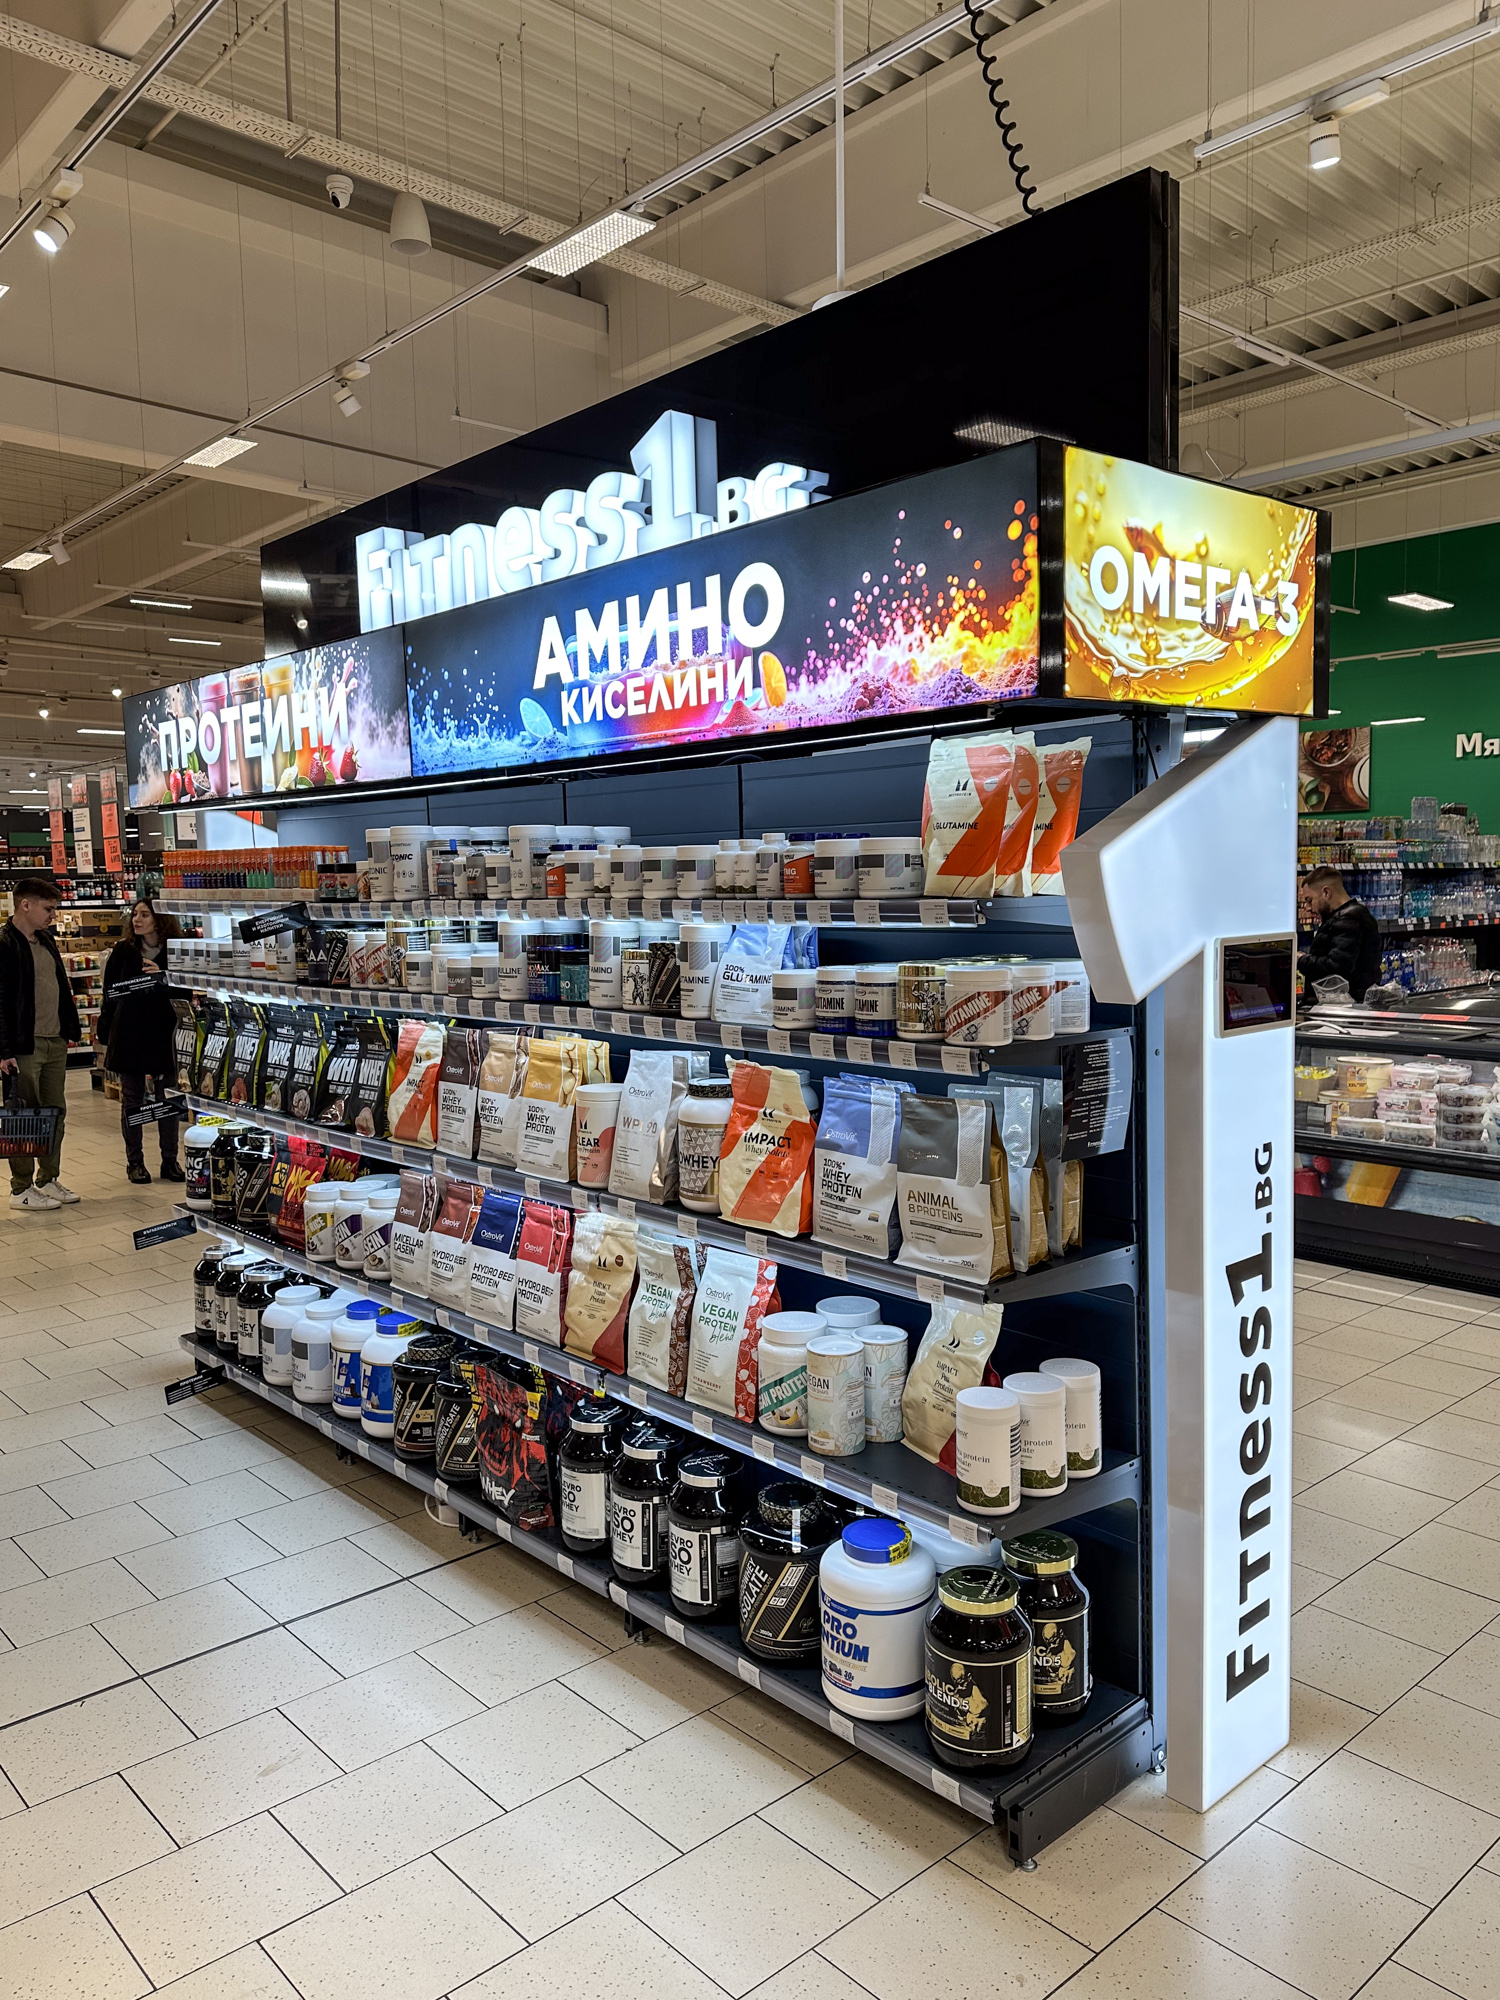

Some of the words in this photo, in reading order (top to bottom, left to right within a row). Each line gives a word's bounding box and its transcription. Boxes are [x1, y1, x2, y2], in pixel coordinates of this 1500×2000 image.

[1089, 544, 1300, 637] ОМЕГА-3
[533, 561, 785, 690] АМИНО
[560, 655, 754, 726] КИСЕЛИНИ
[158, 681, 349, 772] ПРОТЕИНИ
[725, 964, 745, 973] 100%
[175, 1029, 197, 1052] WHEY
[203, 1033, 230, 1058] WHEY
[359, 1058, 387, 1087] WHEY
[442, 1095, 462, 1105] WHEY
[628, 1086, 655, 1098] OstroVit
[441, 1103, 467, 1116] PROTEIN
[480, 1103, 499, 1116] WHEY
[479, 1113, 504, 1126] PROTEIN
[526, 1113, 550, 1124] WHEY
[525, 1122, 556, 1136] PROTEIN
[646, 1121, 658, 1134] 90
[826, 1127, 857, 1142] OstroVit
[745, 1143, 763, 1156] Whey
[822, 1166, 852, 1184] WHEY
[821, 1179, 862, 1200] PROTEIN
[906, 1189, 960, 1211] ANIMAL
[908, 1203, 916, 1214] 8
[917, 1204, 963, 1224] PROTEINS
[394, 1232, 424, 1250] MICELLAR
[480, 1229, 505, 1243] OstroVit
[524, 1242, 544, 1254] OstroVit
[472, 1262, 498, 1277] HYDRO
[498, 1270, 515, 1282] BEEF
[470, 1273, 500, 1289] PROTEIN
[517, 1277, 540, 1292] HYDRO
[517, 1288, 544, 1305] PROTEIN
[645, 1281, 674, 1301] VEGAN
[705, 1287, 733, 1301] OstroVit
[640, 1294, 672, 1312] PROTEIN
[702, 1301, 740, 1323] VEGAN
[698, 1315, 738, 1334] PROTEIN
[708, 1325, 736, 1345] blend
[936, 1360, 959, 1377] IMPACT
[934, 1380, 954, 1396] Protein
[1024, 1439, 1053, 1448] protein
[963, 1452, 991, 1465] protein
[823, 1609, 858, 1640] PRO
